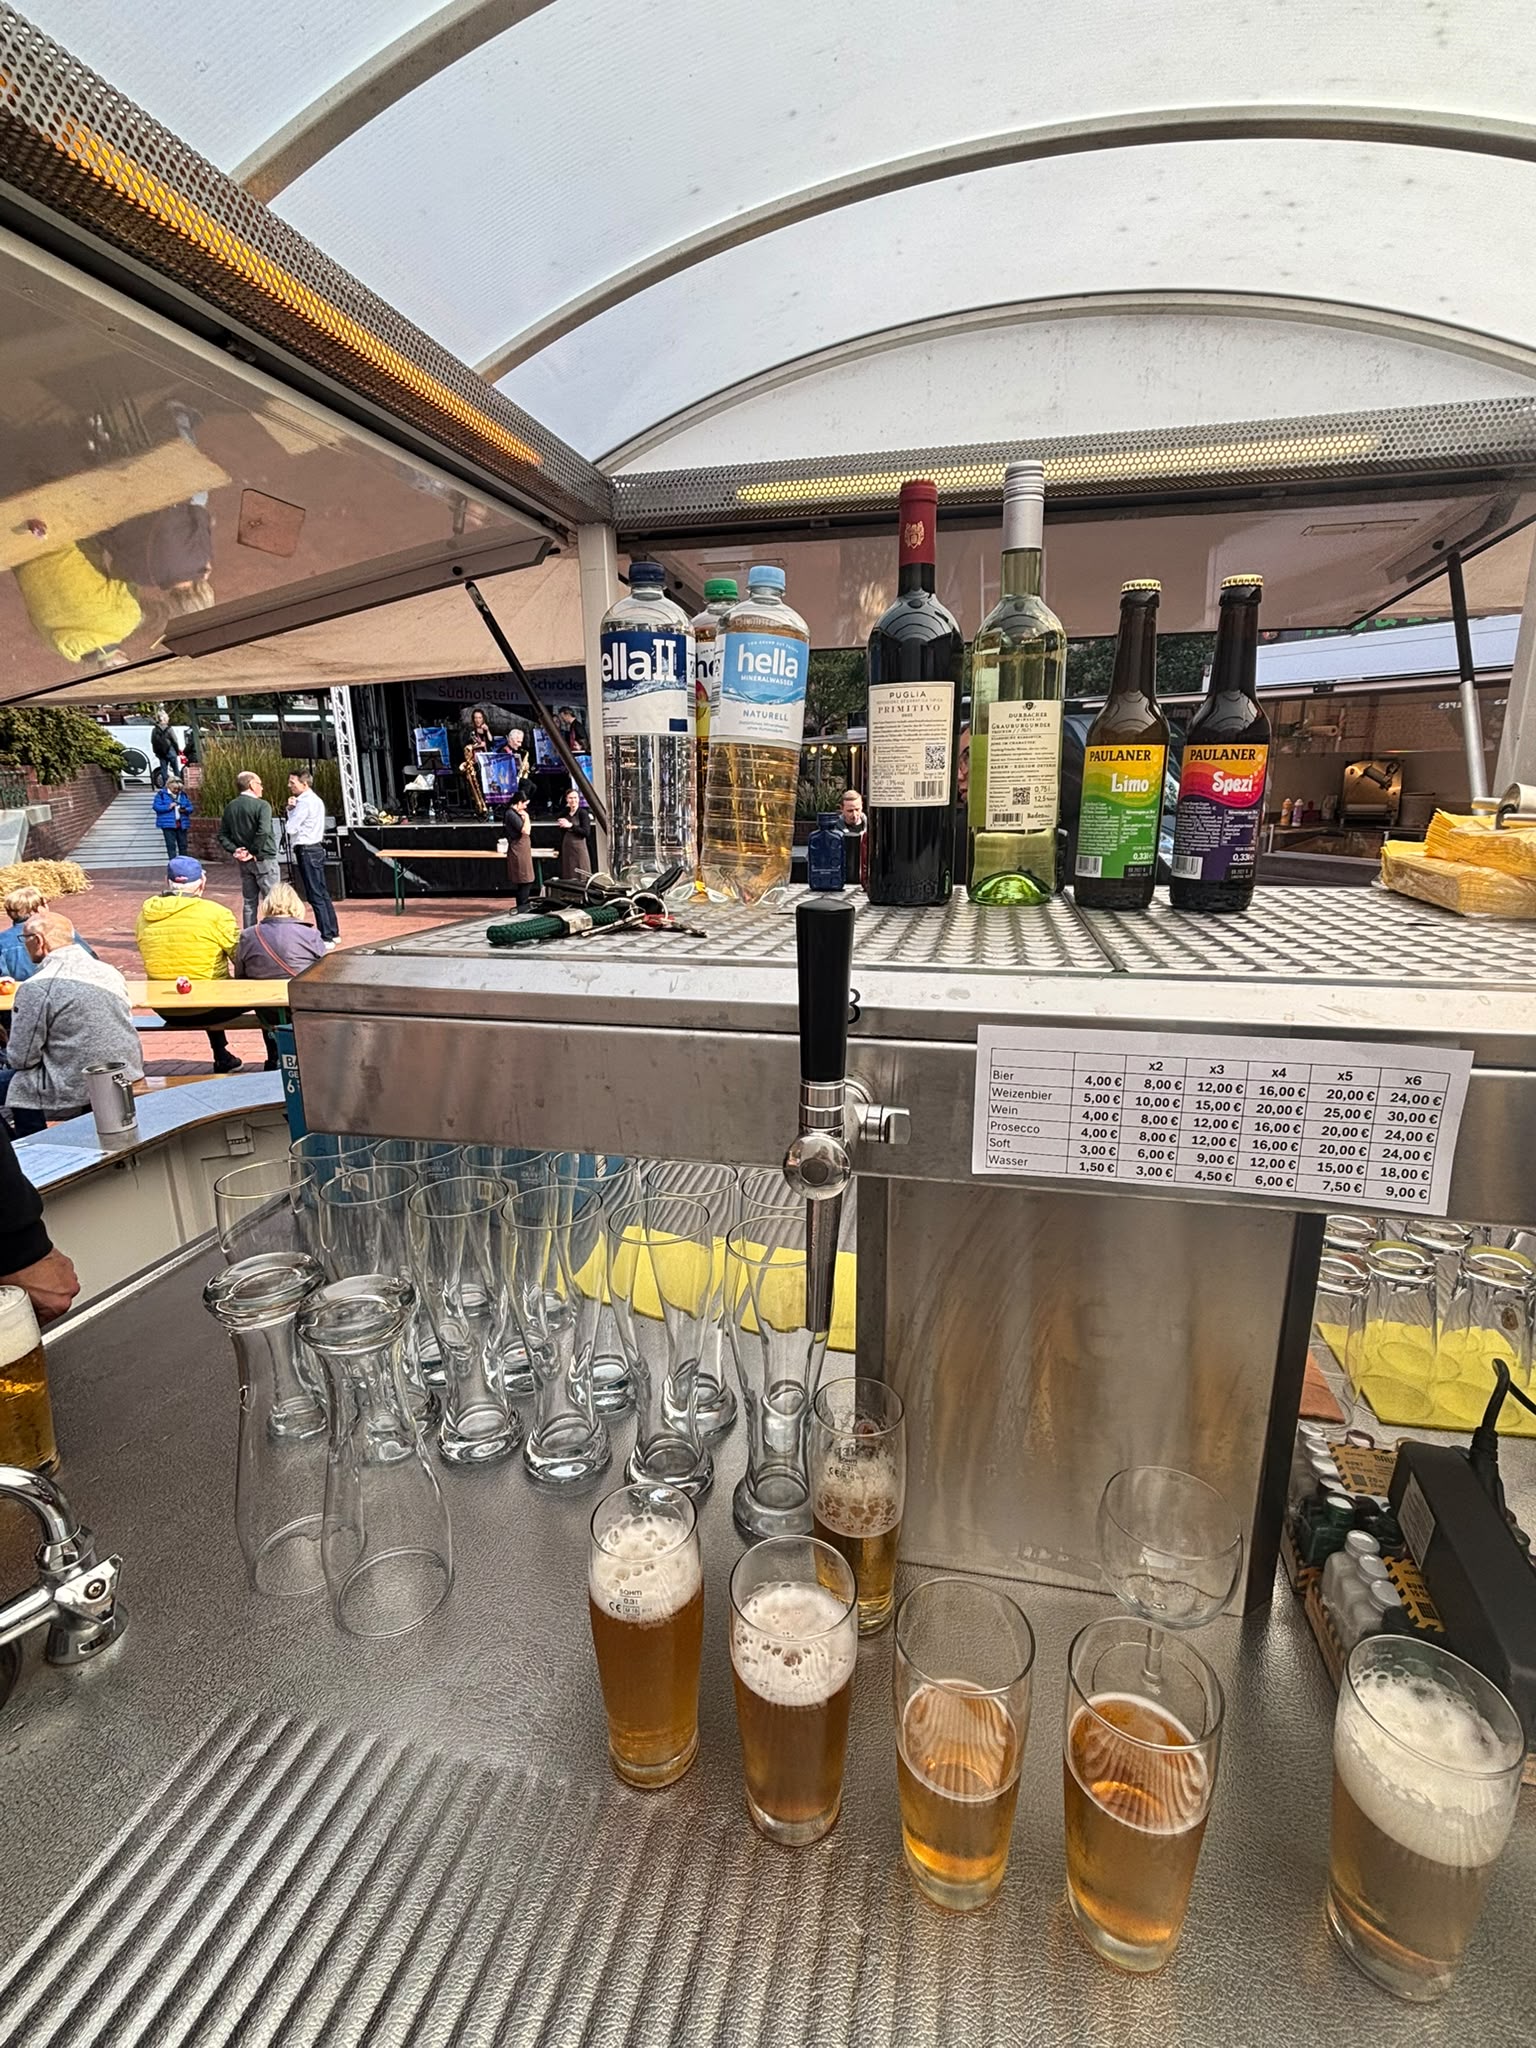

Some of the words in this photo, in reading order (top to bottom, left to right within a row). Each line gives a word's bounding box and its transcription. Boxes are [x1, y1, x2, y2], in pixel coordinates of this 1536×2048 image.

[737, 643, 799, 679] hella
[530, 677, 585, 691] Schröder
[740, 674, 794, 687] MINERALWASSER
[889, 690, 927, 699] PUGLIA
[743, 709, 788, 721] NATURELL
[878, 704, 941, 714] PRIMITIVO
[1089, 749, 1151, 762] PAULANER
[1190, 748, 1256, 761] PAULANER
[1111, 772, 1149, 793] Limo
[1212, 771, 1254, 796] Spezi
[1148, 1061, 1163, 1071] x2
[1209, 1064, 1224, 1075] x3
[1271, 1067, 1287, 1078] x4
[1337, 1071, 1353, 1081] x5
[1404, 1075, 1422, 1086] x6
[993, 1070, 1014, 1080] Bier
[1084, 1075, 1112, 1087] 4,00
[1114, 1077, 1122, 1087] €
[1144, 1079, 1171, 1090] 8,00
[1174, 1080, 1182, 1091] €
[1197, 1082, 1233, 1094] 12,00
[1235, 1084, 1244, 1094] €
[1259, 1085, 1295, 1098] 16,00
[1297, 1087, 1306, 1098] €
[1326, 1089, 1364, 1101] 20,00
[1366, 1091, 1375, 1101] €
[1390, 1092, 1430, 1105] 24,00
[1433, 1096, 1442, 1106] €
[992, 1087, 1052, 1100] Weizenbier
[1083, 1093, 1110, 1104] 5,00
[1113, 1095, 1120, 1105] €
[1136, 1096, 1170, 1108] 10,00
[1172, 1099, 1180, 1109] €
[1196, 1100, 1231, 1112] 15,00
[1233, 1102, 1242, 1112] €
[1256, 1104, 1293, 1116] 20,00
[1295, 1106, 1303, 1116] €
[1323, 1107, 1361, 1120] 25,00
[1364, 1110, 1372, 1120] €
[1387, 1111, 1426, 1124] 30,00
[1429, 1114, 1438, 1124] €
[991, 1104, 1018, 1115] Wein
[1082, 1110, 1109, 1122] 4,00
[1111, 1112, 1119, 1122] €
[1141, 1114, 1168, 1125] 8,00
[1170, 1116, 1179, 1126] €
[1194, 1118, 1228, 1130] 12,00
[1231, 1120, 1239, 1130] €
[1254, 1122, 1290, 1134] 16,00
[1293, 1124, 1301, 1134] €
[1321, 1126, 1358, 1138] 20,00
[1361, 1128, 1369, 1138] €
[1384, 1129, 1423, 1142] 24,00
[1426, 1132, 1435, 1143] €
[991, 1121, 1040, 1134] Prosecco
[1081, 1128, 1107, 1139] 4,00
[1110, 1129, 1118, 1139] €
[1139, 1131, 1166, 1143] 8,00
[1169, 1133, 1177, 1143] €
[1192, 1135, 1226, 1147] 12,00
[1229, 1138, 1237, 1148] €
[1252, 1139, 1288, 1151] 16,00
[1290, 1142, 1299, 1152] €
[1318, 1144, 1356, 1156] 20,00
[1358, 1146, 1367, 1157] €
[1382, 1148, 1420, 1161] 24,00
[1423, 1151, 1432, 1162] €
[989, 1138, 1010, 1148] Soft
[1080, 1144, 1106, 1156] 3,00
[1108, 1146, 1116, 1156] €
[1137, 1148, 1164, 1160] 6,00
[1167, 1151, 1175, 1161] €
[1197, 1153, 1224, 1164] 9,00
[1227, 1155, 1235, 1165] €
[1250, 1157, 1286, 1169] 12,00
[1288, 1160, 1296, 1170] €
[1317, 1162, 1353, 1174] 15,00
[1356, 1165, 1365, 1175] €
[1380, 1167, 1418, 1180] 18,00
[1421, 1170, 1430, 1181] €
[988, 1155, 1028, 1167] Wasser
[1079, 1162, 1105, 1172] 1,50
[1107, 1163, 1115, 1173] €
[1136, 1166, 1163, 1177] 3,00
[1165, 1168, 1173, 1178] €
[1194, 1170, 1222, 1181] 4,50
[1225, 1173, 1233, 1182] €
[1255, 1175, 1283, 1187] 6,00
[1286, 1178, 1294, 1188] €
[1322, 1180, 1351, 1192] 7,50
[1354, 1183, 1362, 1193] €
[1385, 1186, 1415, 1198] 9,00
[1418, 1189, 1427, 1199] €
